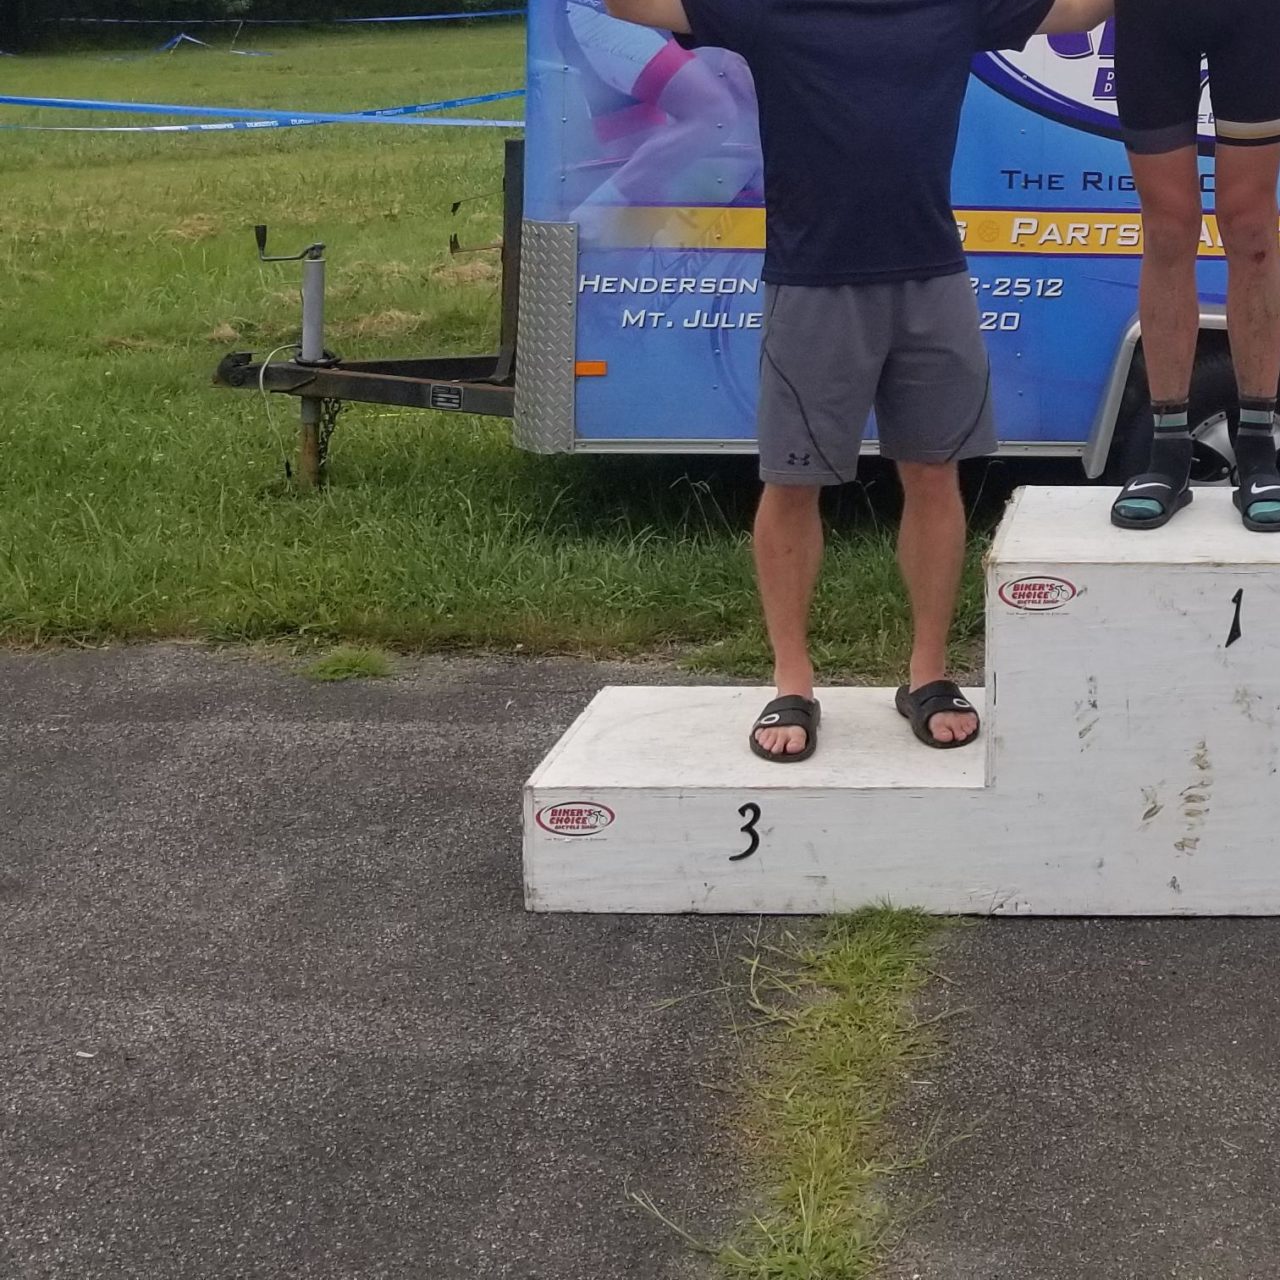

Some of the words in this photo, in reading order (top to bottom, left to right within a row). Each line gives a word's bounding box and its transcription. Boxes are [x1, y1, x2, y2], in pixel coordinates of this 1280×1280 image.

[1082, 172, 1137, 192] RIG
[1009, 217, 1142, 247] PARTS
[578, 274, 765, 295] HENDERSON
[682, 310, 763, 329] JULIE
[979, 311, 1021, 331] 20
[1011, 591, 1050, 600] CHOICE
[1012, 583, 1056, 592] BIKER'S
[1225, 587, 1244, 648] 1
[549, 816, 588, 825] CHOICE
[550, 808, 593, 817] BIKER'S
[729, 802, 761, 861] 3
